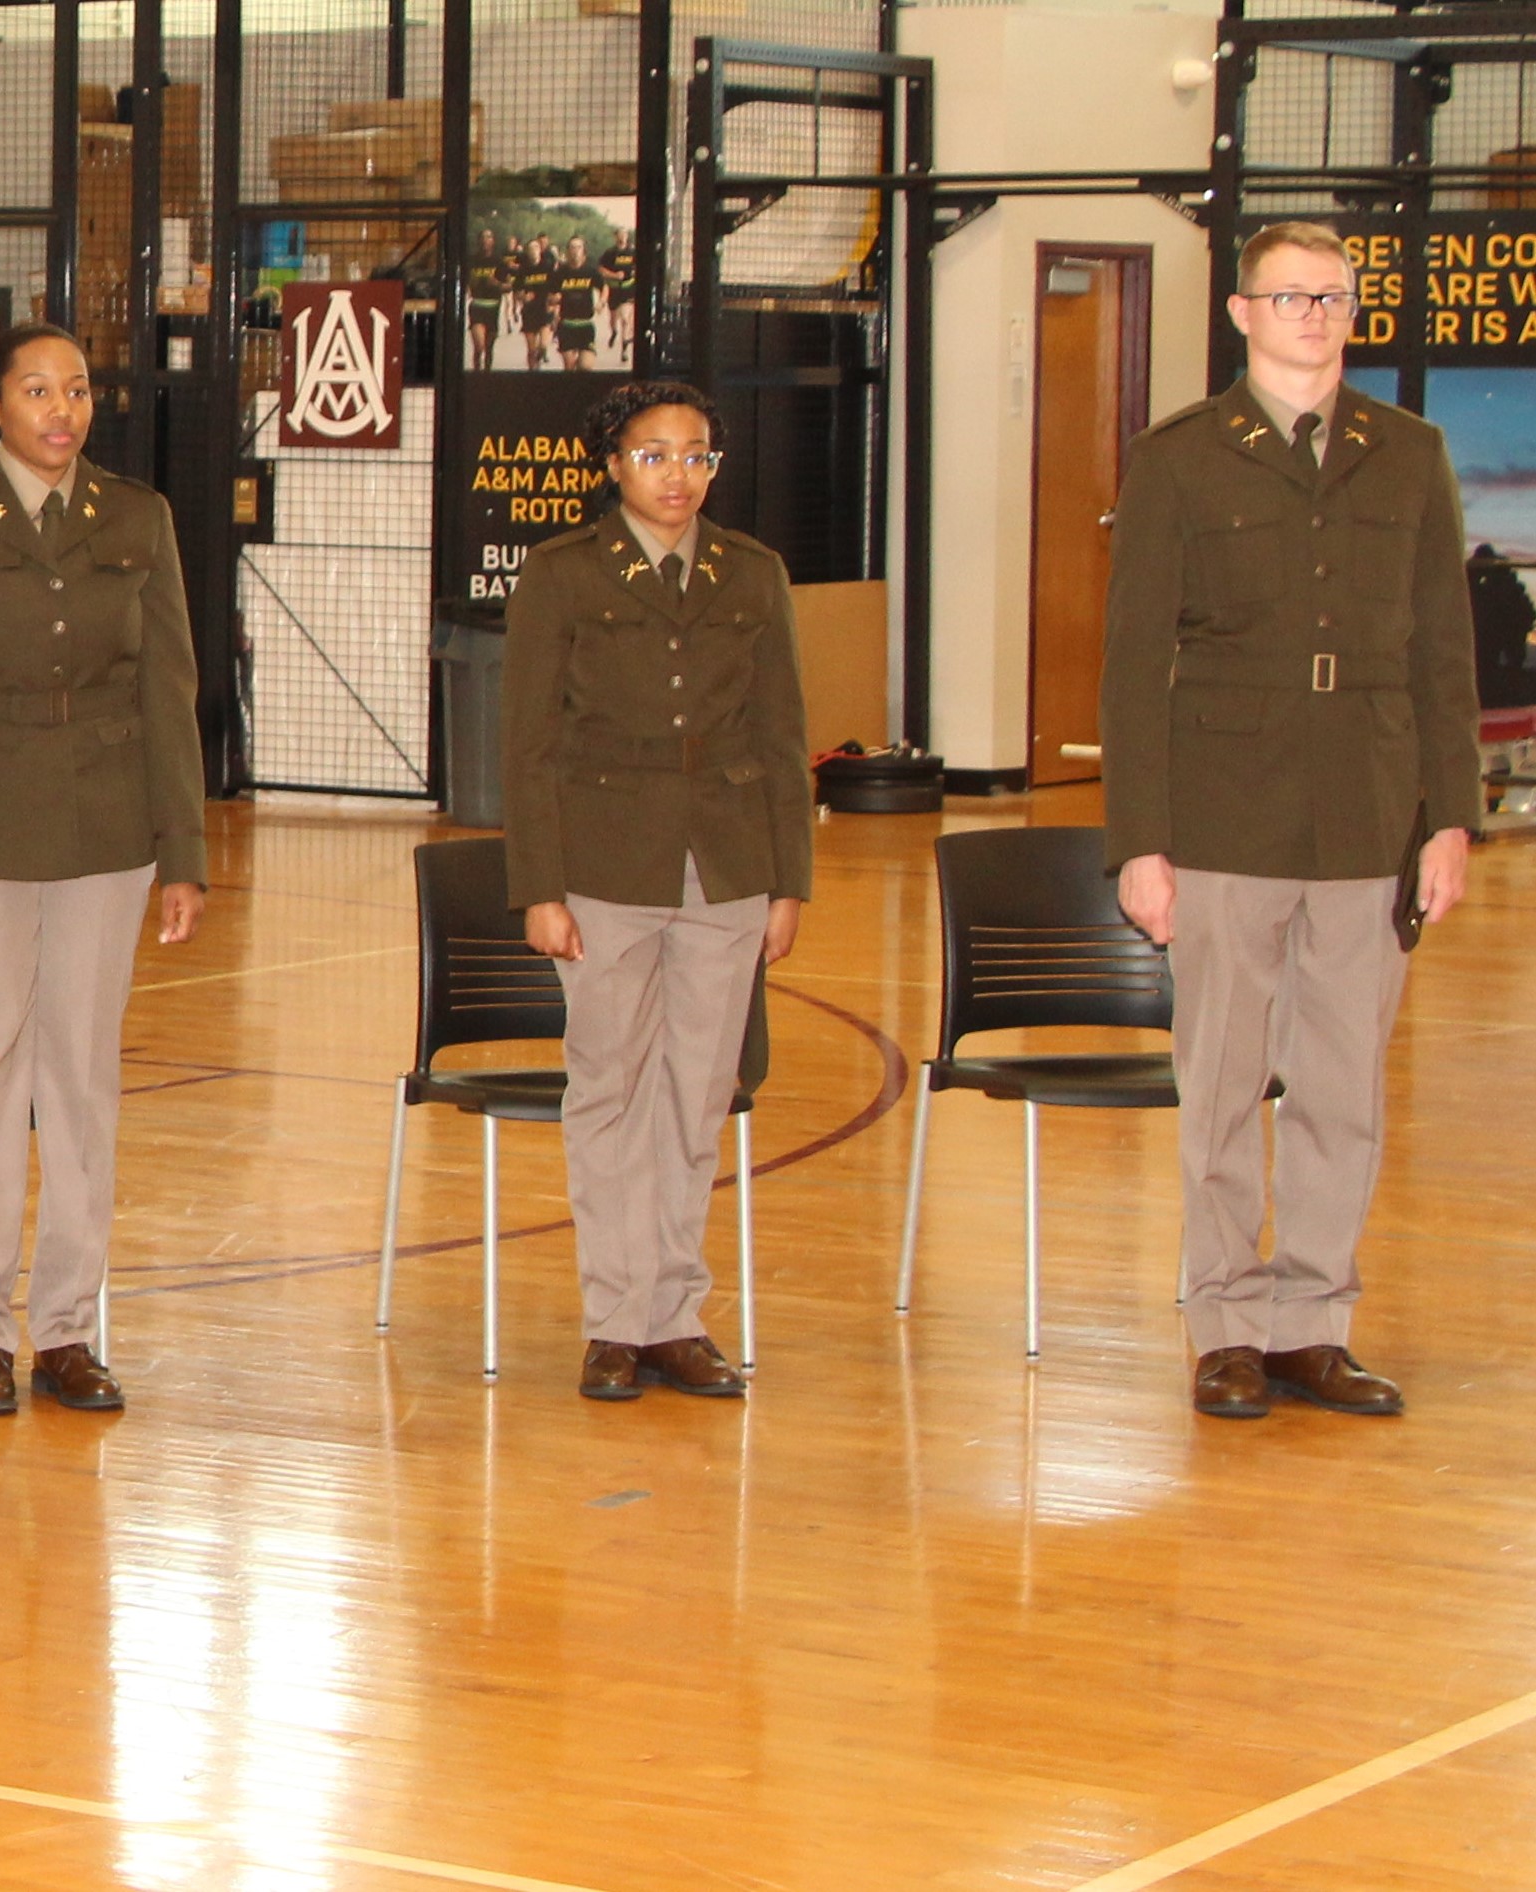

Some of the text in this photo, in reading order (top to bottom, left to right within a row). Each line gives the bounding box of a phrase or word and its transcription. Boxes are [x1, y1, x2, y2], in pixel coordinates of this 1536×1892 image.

[562, 277, 592, 289] ARMY
[1471, 310, 1508, 345] IS
[472, 466, 604, 493] A&M ARM
[511, 497, 583, 524] ROTC
